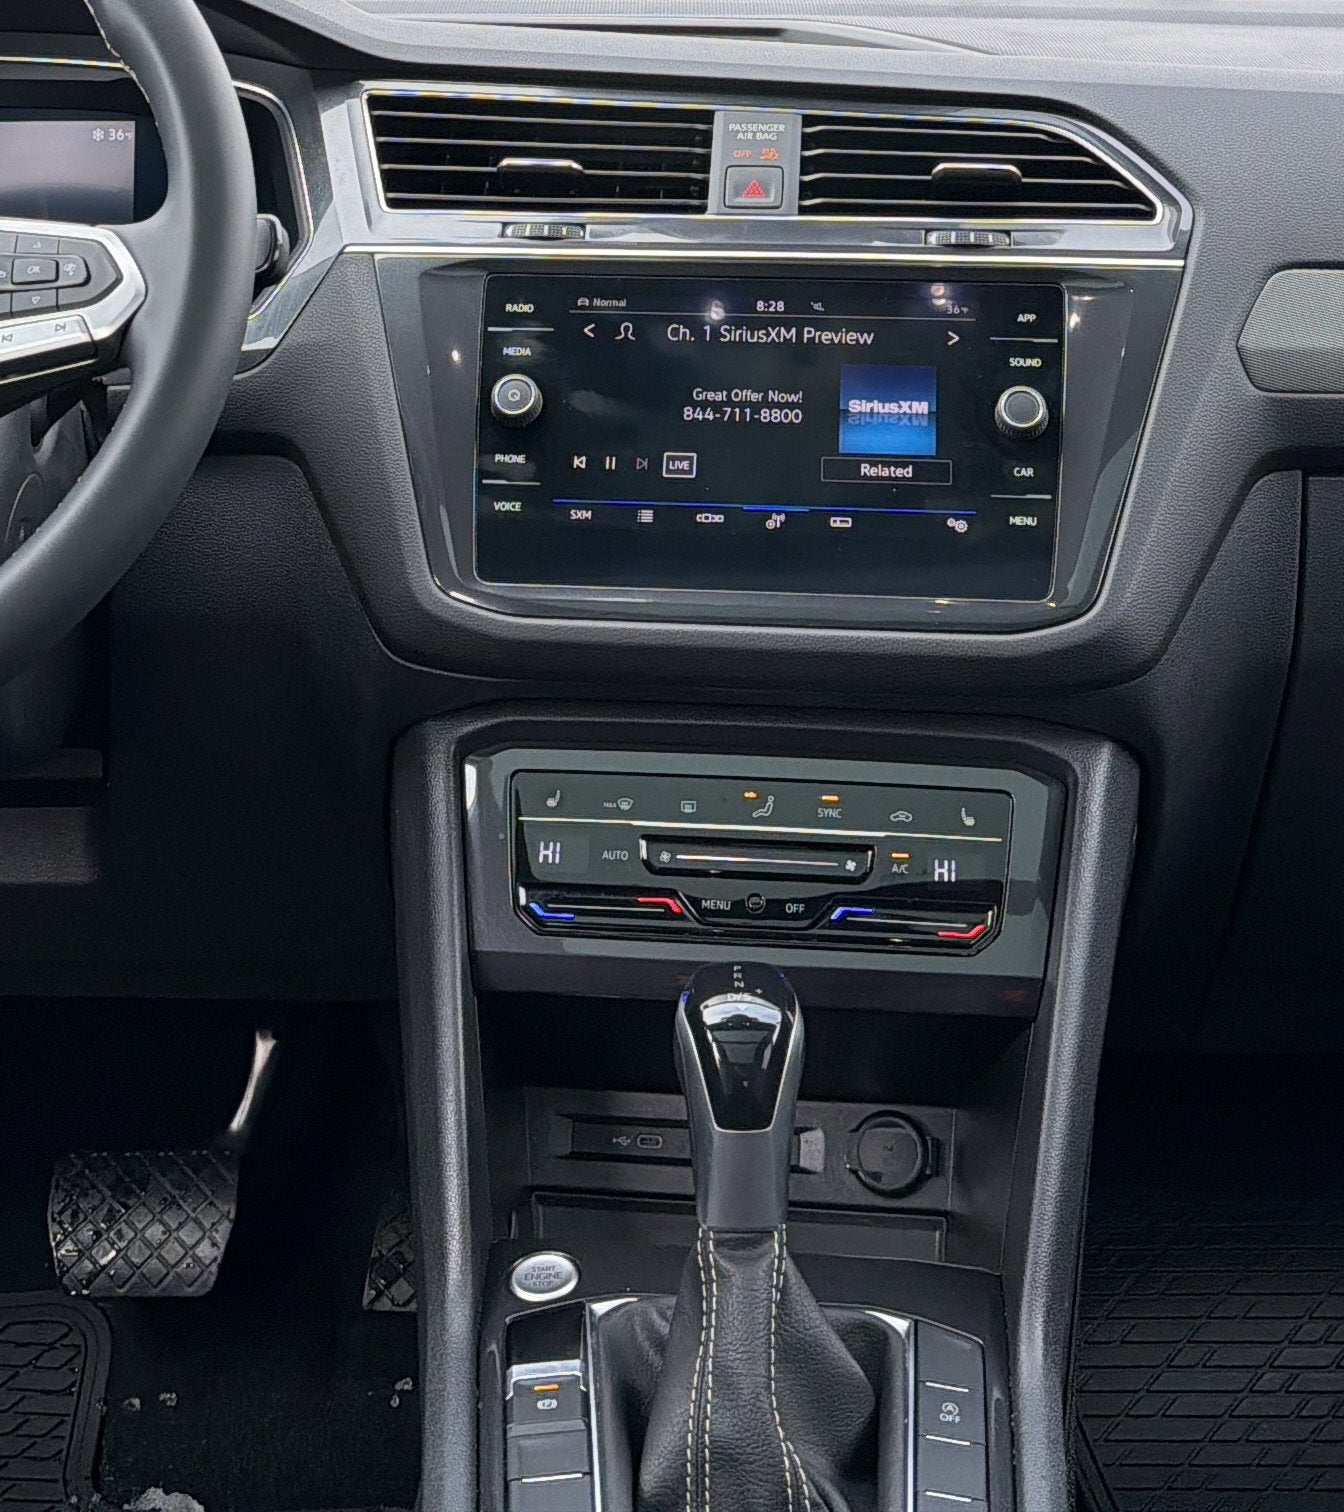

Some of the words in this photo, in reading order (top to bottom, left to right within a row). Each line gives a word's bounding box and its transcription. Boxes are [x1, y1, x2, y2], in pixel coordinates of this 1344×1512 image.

[728, 123, 786, 132] PASSENGER
[737, 132, 753, 140] AIR
[755, 132, 778, 140] BAG
[732, 149, 753, 158] OFF
[27, 265, 41, 275] OK
[593, 297, 627, 308] Normal
[756, 300, 785, 312] 8:28
[505, 303, 535, 314] RADIO
[1017, 313, 1037, 324] APP
[666, 324, 695, 342] Ch.
[703, 326, 711, 342] 1
[719, 325, 796, 345] SiriusXM
[803, 327, 875, 346] Preview
[502, 347, 532, 357] MEDIA
[1009, 357, 1041, 368] SOUND
[693, 389, 727, 402] Great
[731, 389, 764, 402] Offer
[768, 390, 803, 403] Now!
[848, 399, 929, 414] SiriusXM
[683, 406, 803, 423] 844-711-8800
[494, 454, 526, 464] PHONE
[669, 460, 690, 470] LIVE
[860, 464, 913, 478] Related
[1013, 467, 1034, 477] CAR
[493, 501, 522, 512] VOICE
[569, 510, 592, 520] SXM
[1009, 515, 1037, 527] MENU
[817, 808, 843, 819] SYNC
[538, 841, 561, 864] HI
[601, 849, 629, 861] AUTO
[891, 863, 909, 874] A/C
[935, 859, 956, 882] HI
[701, 899, 731, 911] MENU
[785, 902, 805, 914] OFF
[734, 980, 744, 988] N
[532, 1265, 557, 1273] START
[524, 1271, 563, 1281] ENGINE
[939, 1413, 961, 1424] OFF
